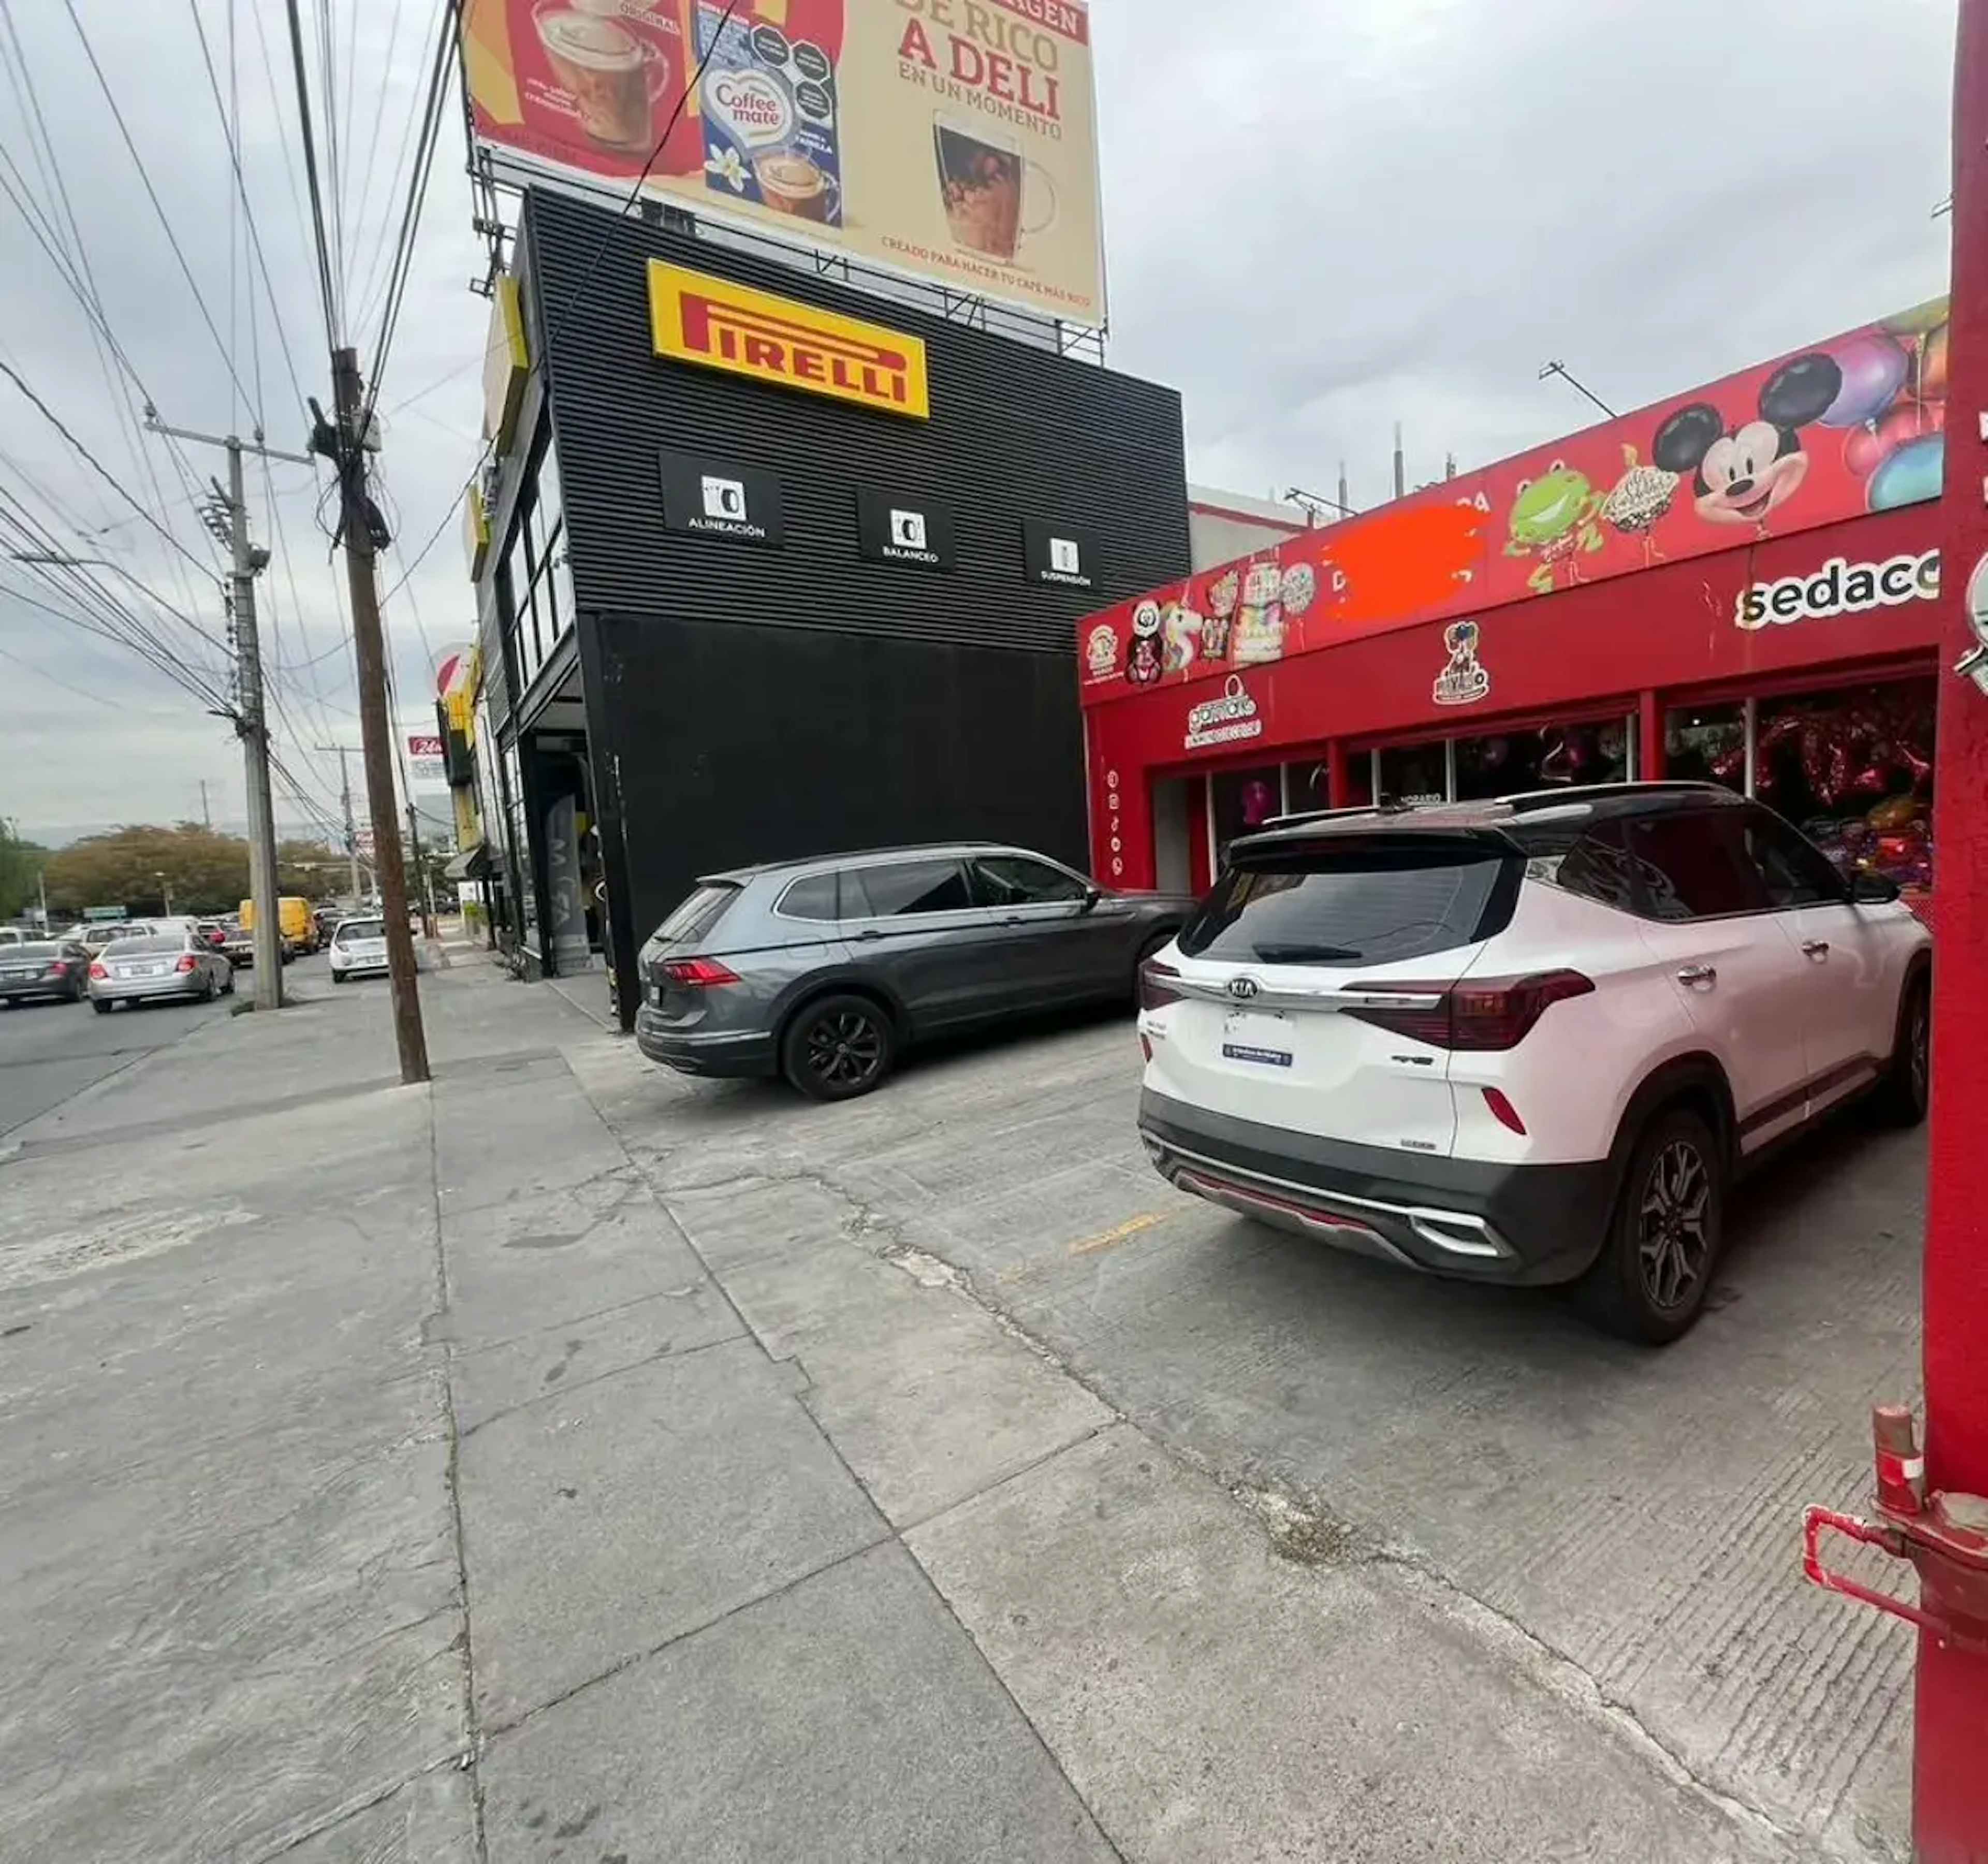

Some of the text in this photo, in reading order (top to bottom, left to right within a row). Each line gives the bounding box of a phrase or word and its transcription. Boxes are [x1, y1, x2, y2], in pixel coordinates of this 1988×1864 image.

[995, 0, 1078, 35] AGEN
[963, 1, 1058, 72] RICO
[899, 17, 1061, 121] A DELI
[715, 83, 777, 112] Coffee
[899, 61, 1062, 141] EN UN MOMENTO
[732, 108, 781, 125] mate
[882, 236, 928, 259] CREADO
[930, 252, 958, 267] PARA
[962, 260, 998, 279] HACER
[1001, 272, 1015, 284] TU
[679, 290, 907, 404] PIRELLI
[688, 517, 765, 537] ALINEACIÓN
[882, 545, 940, 563] BALANCEO
[1041, 570, 1091, 586] SUSPENSIÓN
[1232, 980, 1253, 996] KIA
